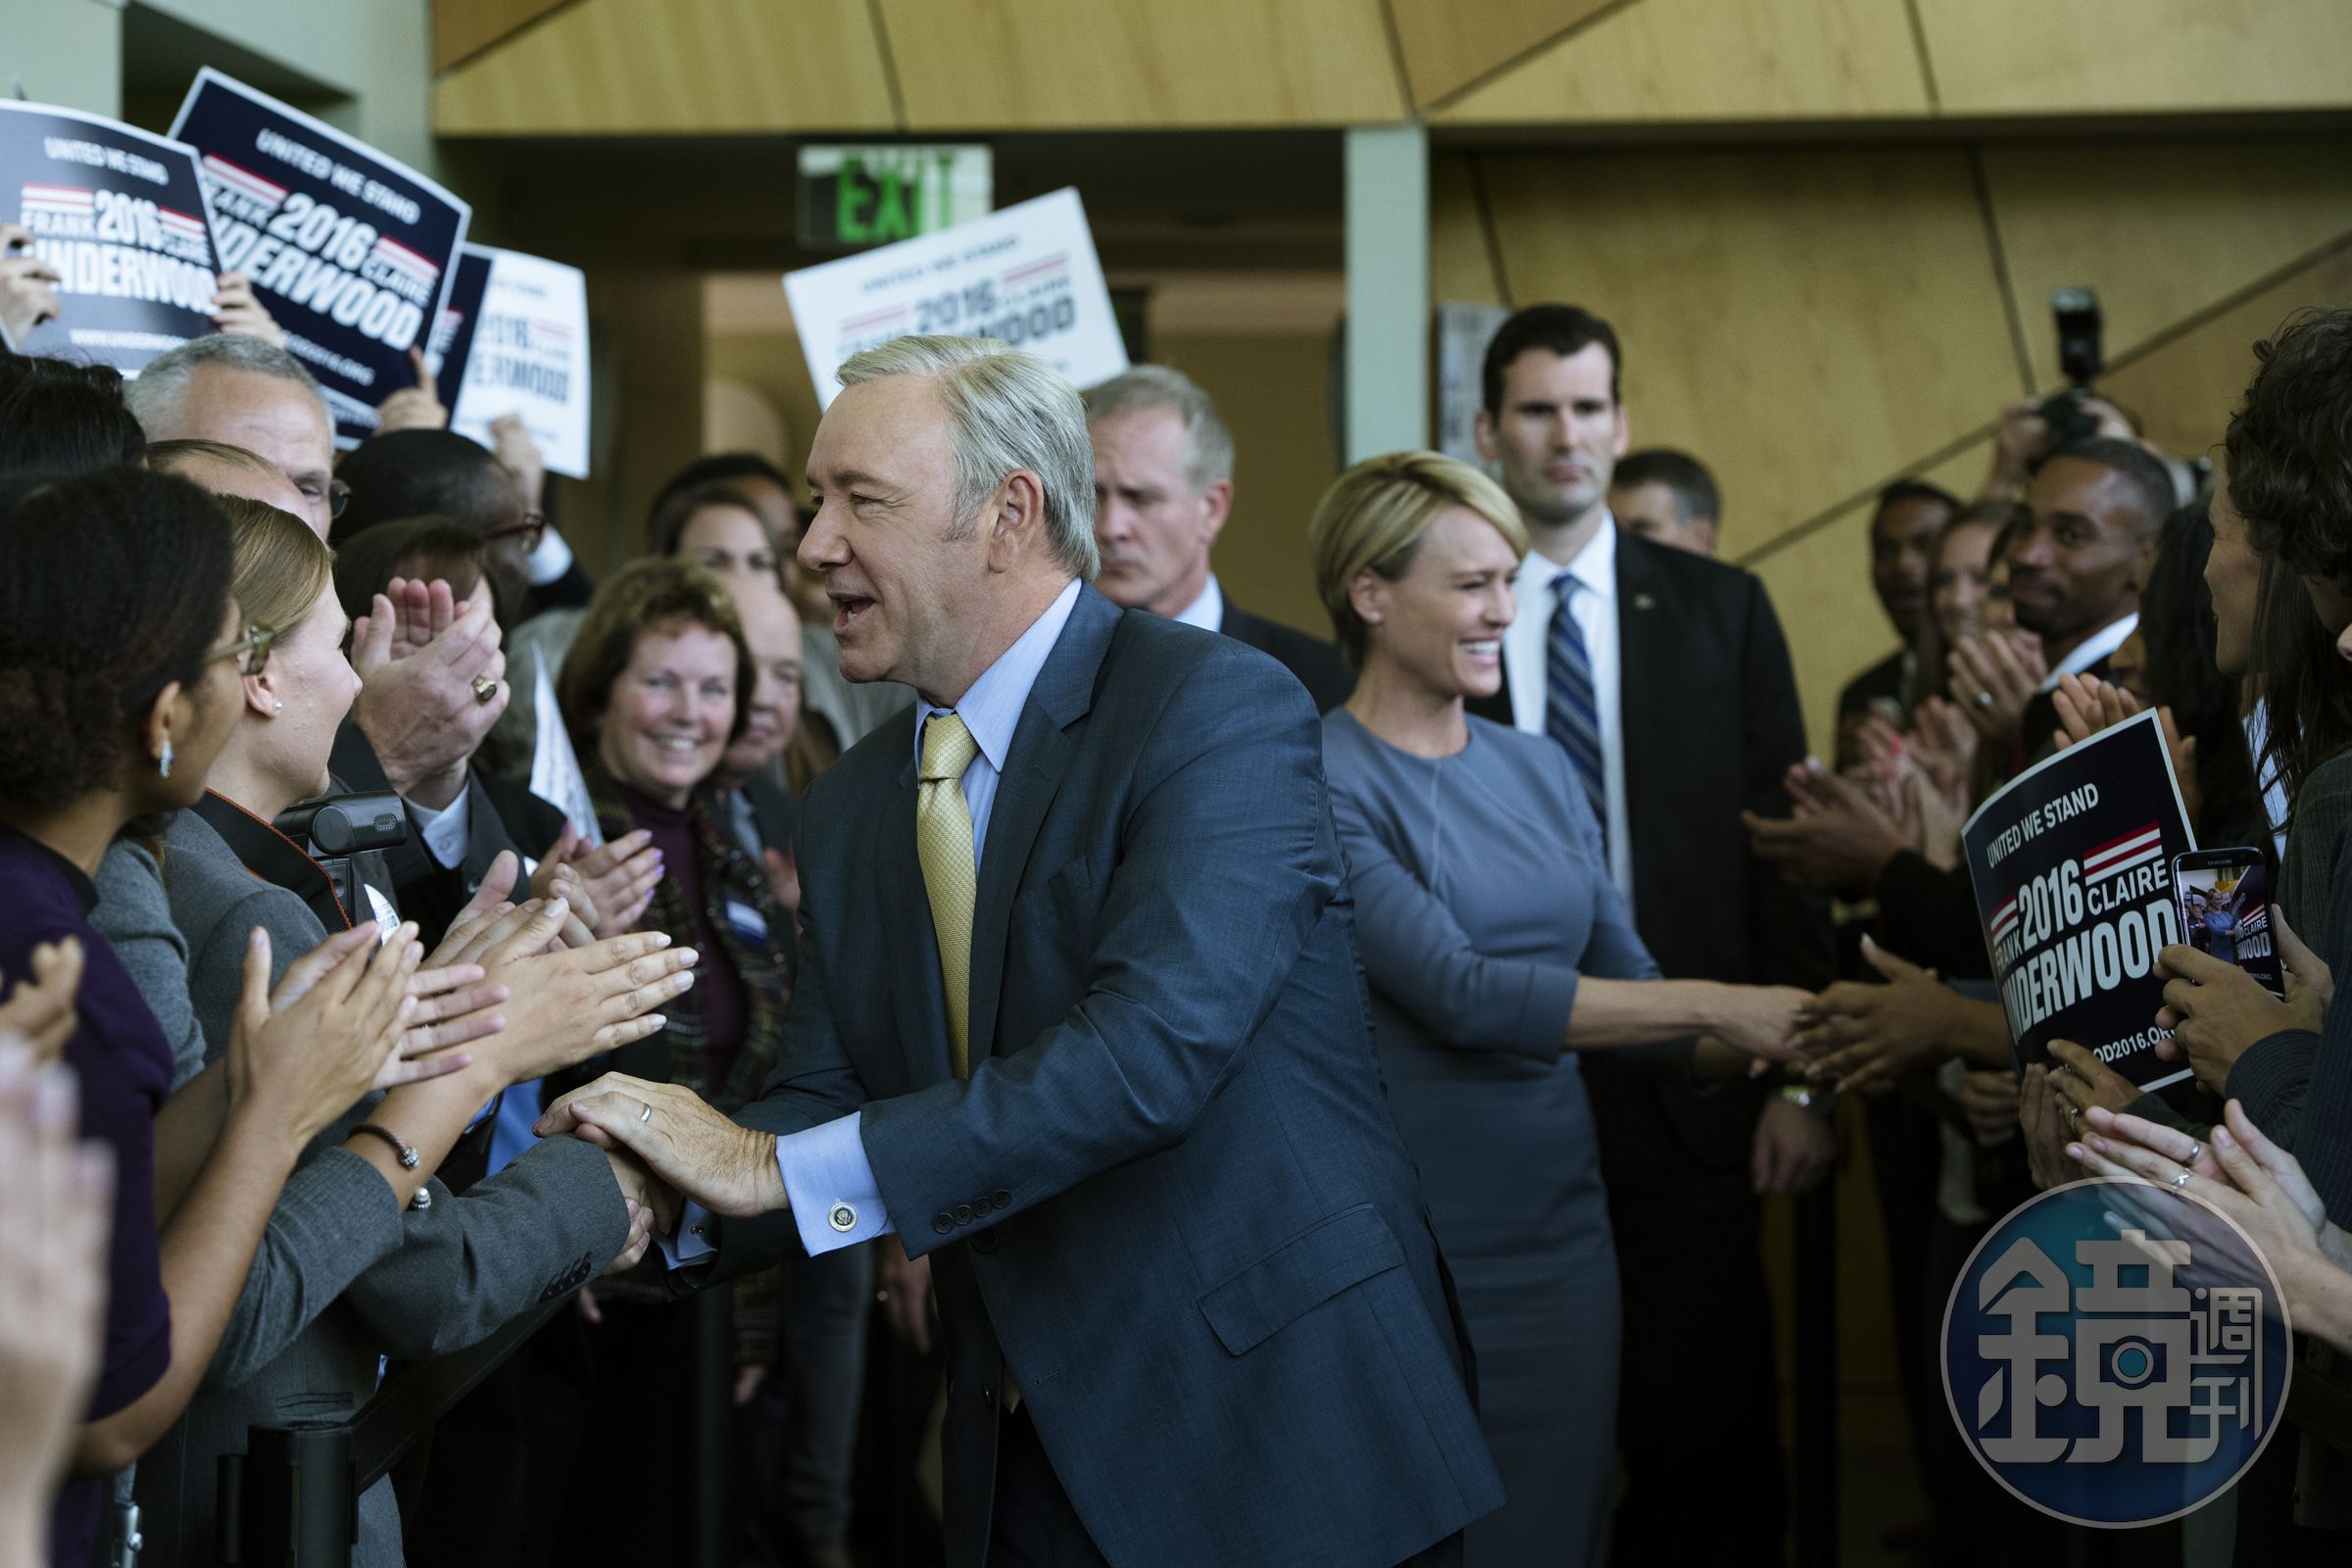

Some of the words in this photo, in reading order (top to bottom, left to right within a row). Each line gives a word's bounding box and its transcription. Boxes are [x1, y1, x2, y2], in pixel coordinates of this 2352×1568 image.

[331, 164, 367, 197] WE
[95, 189, 164, 251] 2016
[267, 192, 379, 271] 2016
[215, 212, 424, 351] DERWOOD
[916, 278, 996, 332] 2016
[1986, 824, 2022, 869] UNITED
[2021, 809, 2044, 843] WE
[2043, 783, 2099, 829] STAND
[2018, 858, 2083, 951] 2016
[2086, 858, 2170, 915] CLAIRE
[1994, 928, 2024, 973] FRANK
[2236, 931, 2272, 960] WOOD
